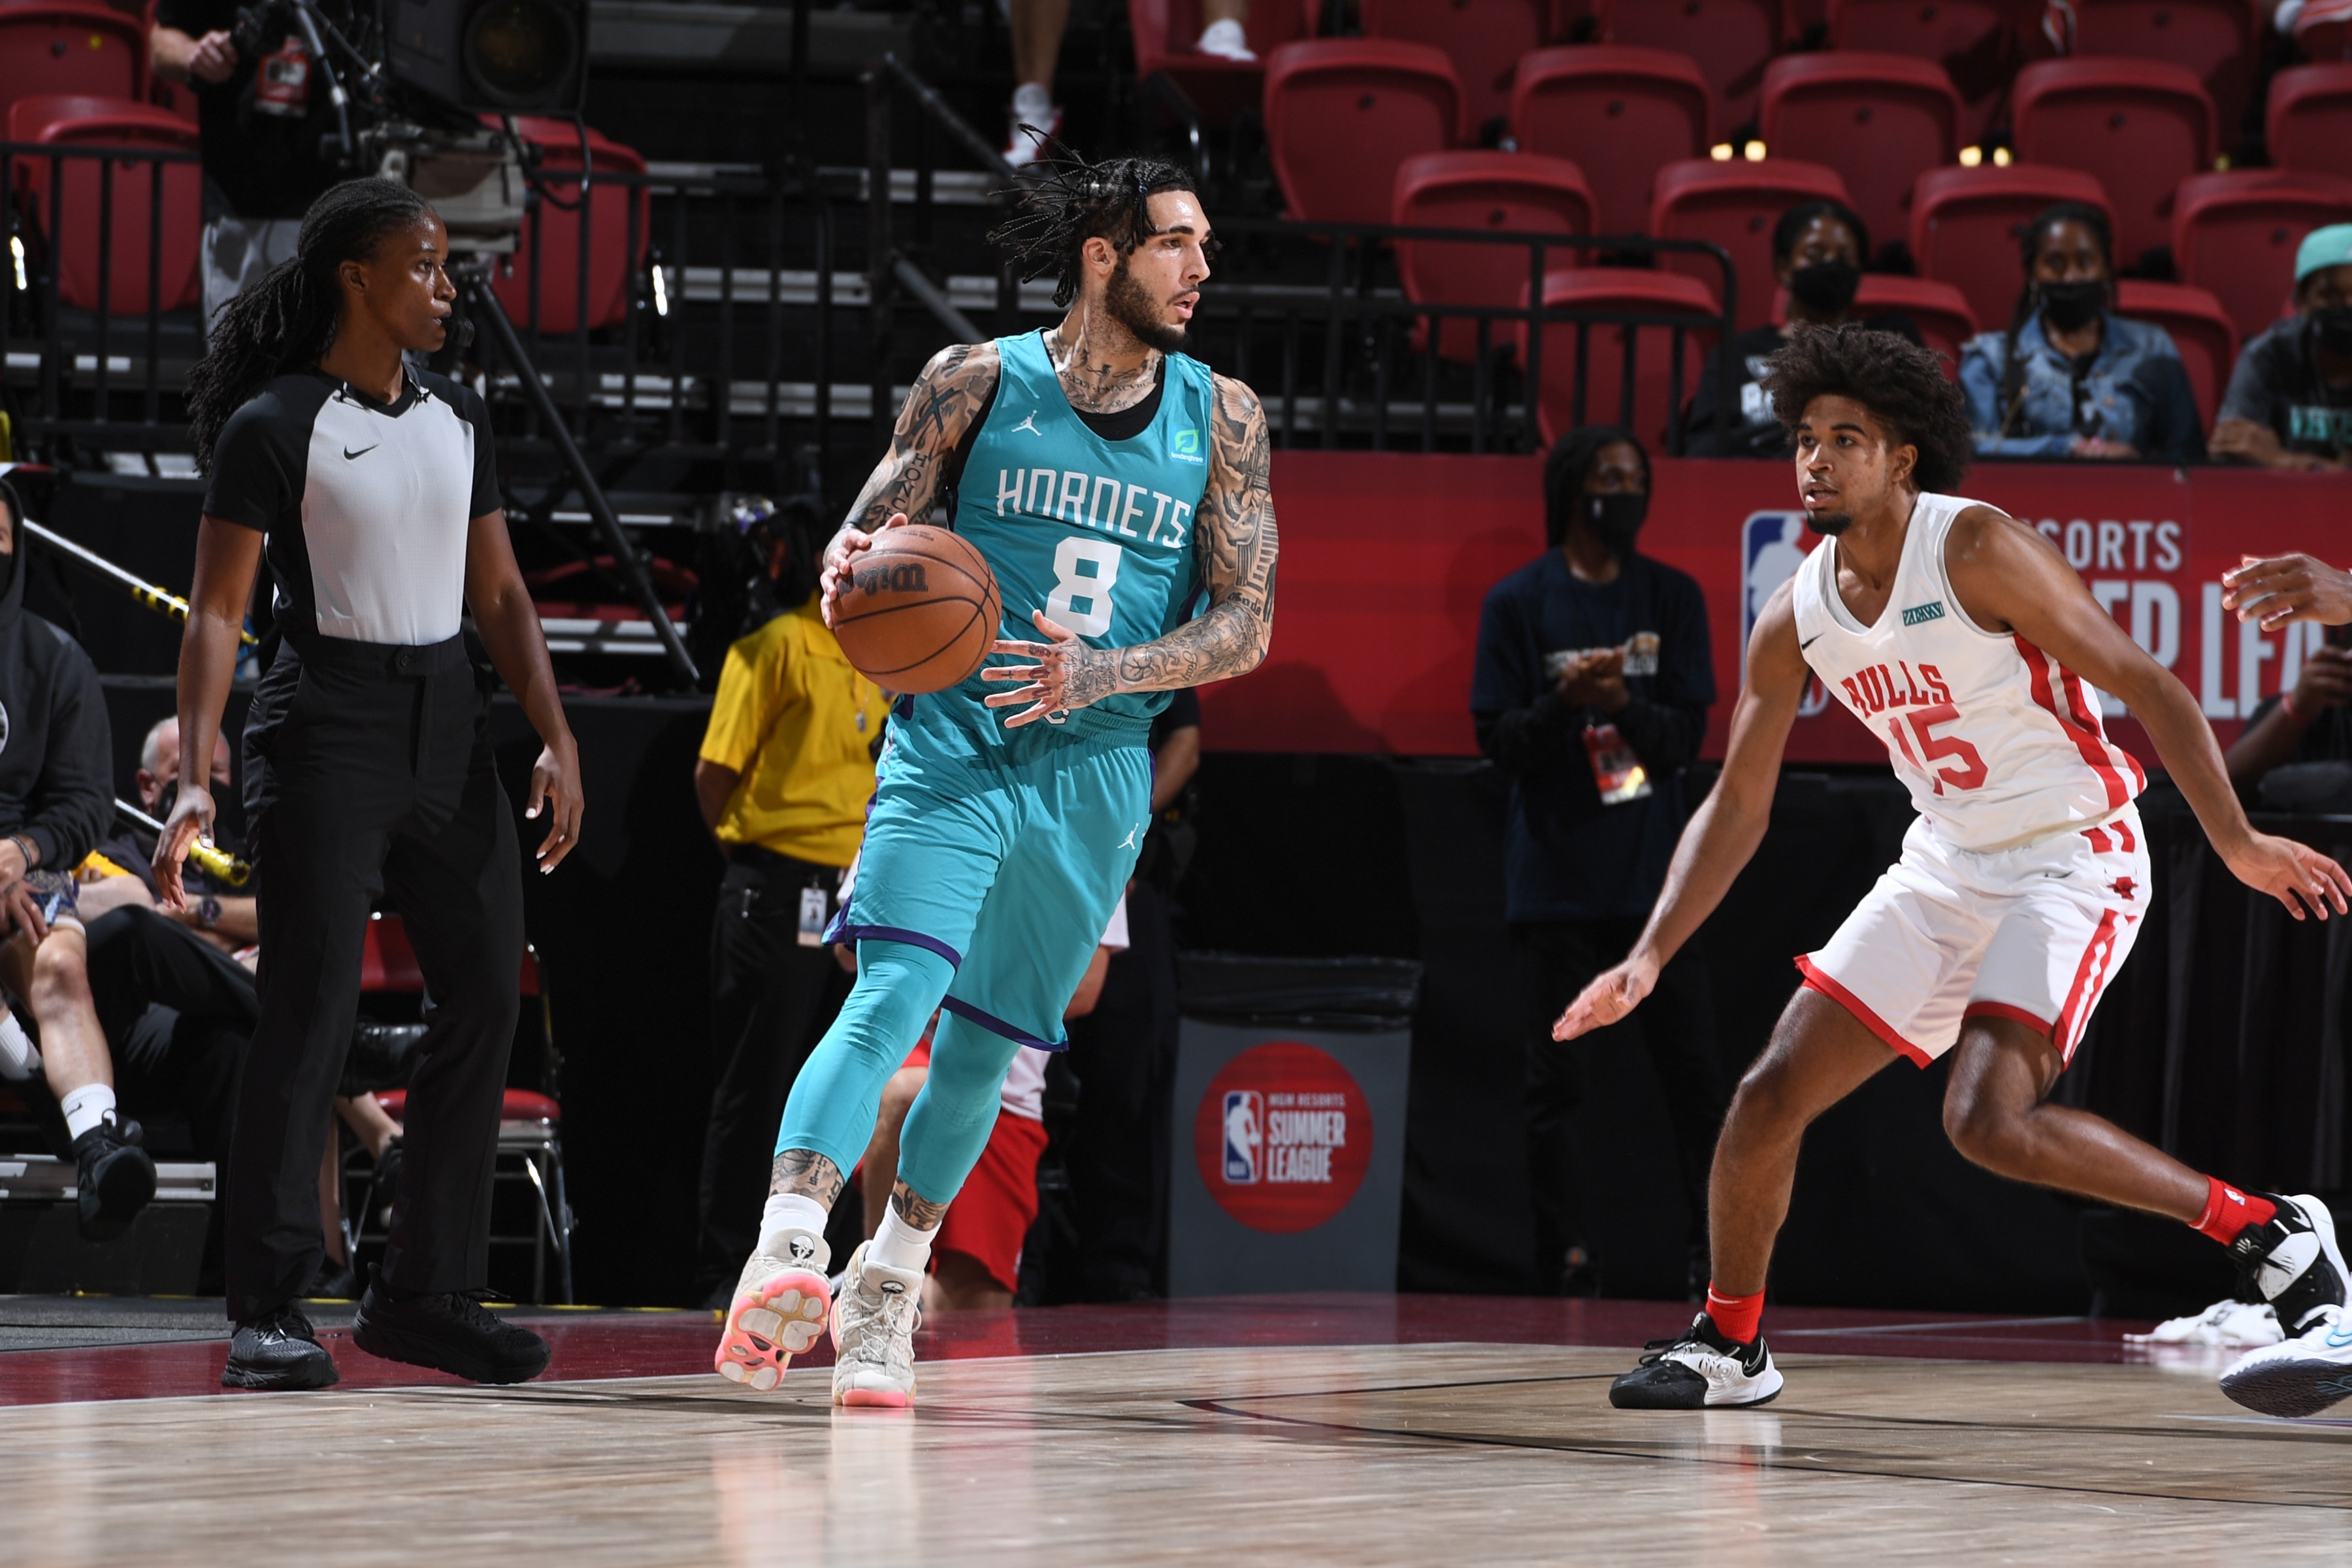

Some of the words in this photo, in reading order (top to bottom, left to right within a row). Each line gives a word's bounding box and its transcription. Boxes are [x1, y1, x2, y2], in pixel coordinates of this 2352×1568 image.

[1171, 451, 1203, 463] lendingtree
[996, 468, 1191, 549] HORNETS
[1045, 536, 1122, 638] 8
[1840, 660, 1955, 719] BULLS
[1888, 703, 1989, 796] 15
[1298, 1094, 1346, 1108] RESORTS
[1268, 1110, 1347, 1147] SUMMER
[1267, 1147, 1332, 1184] LEAGUE
